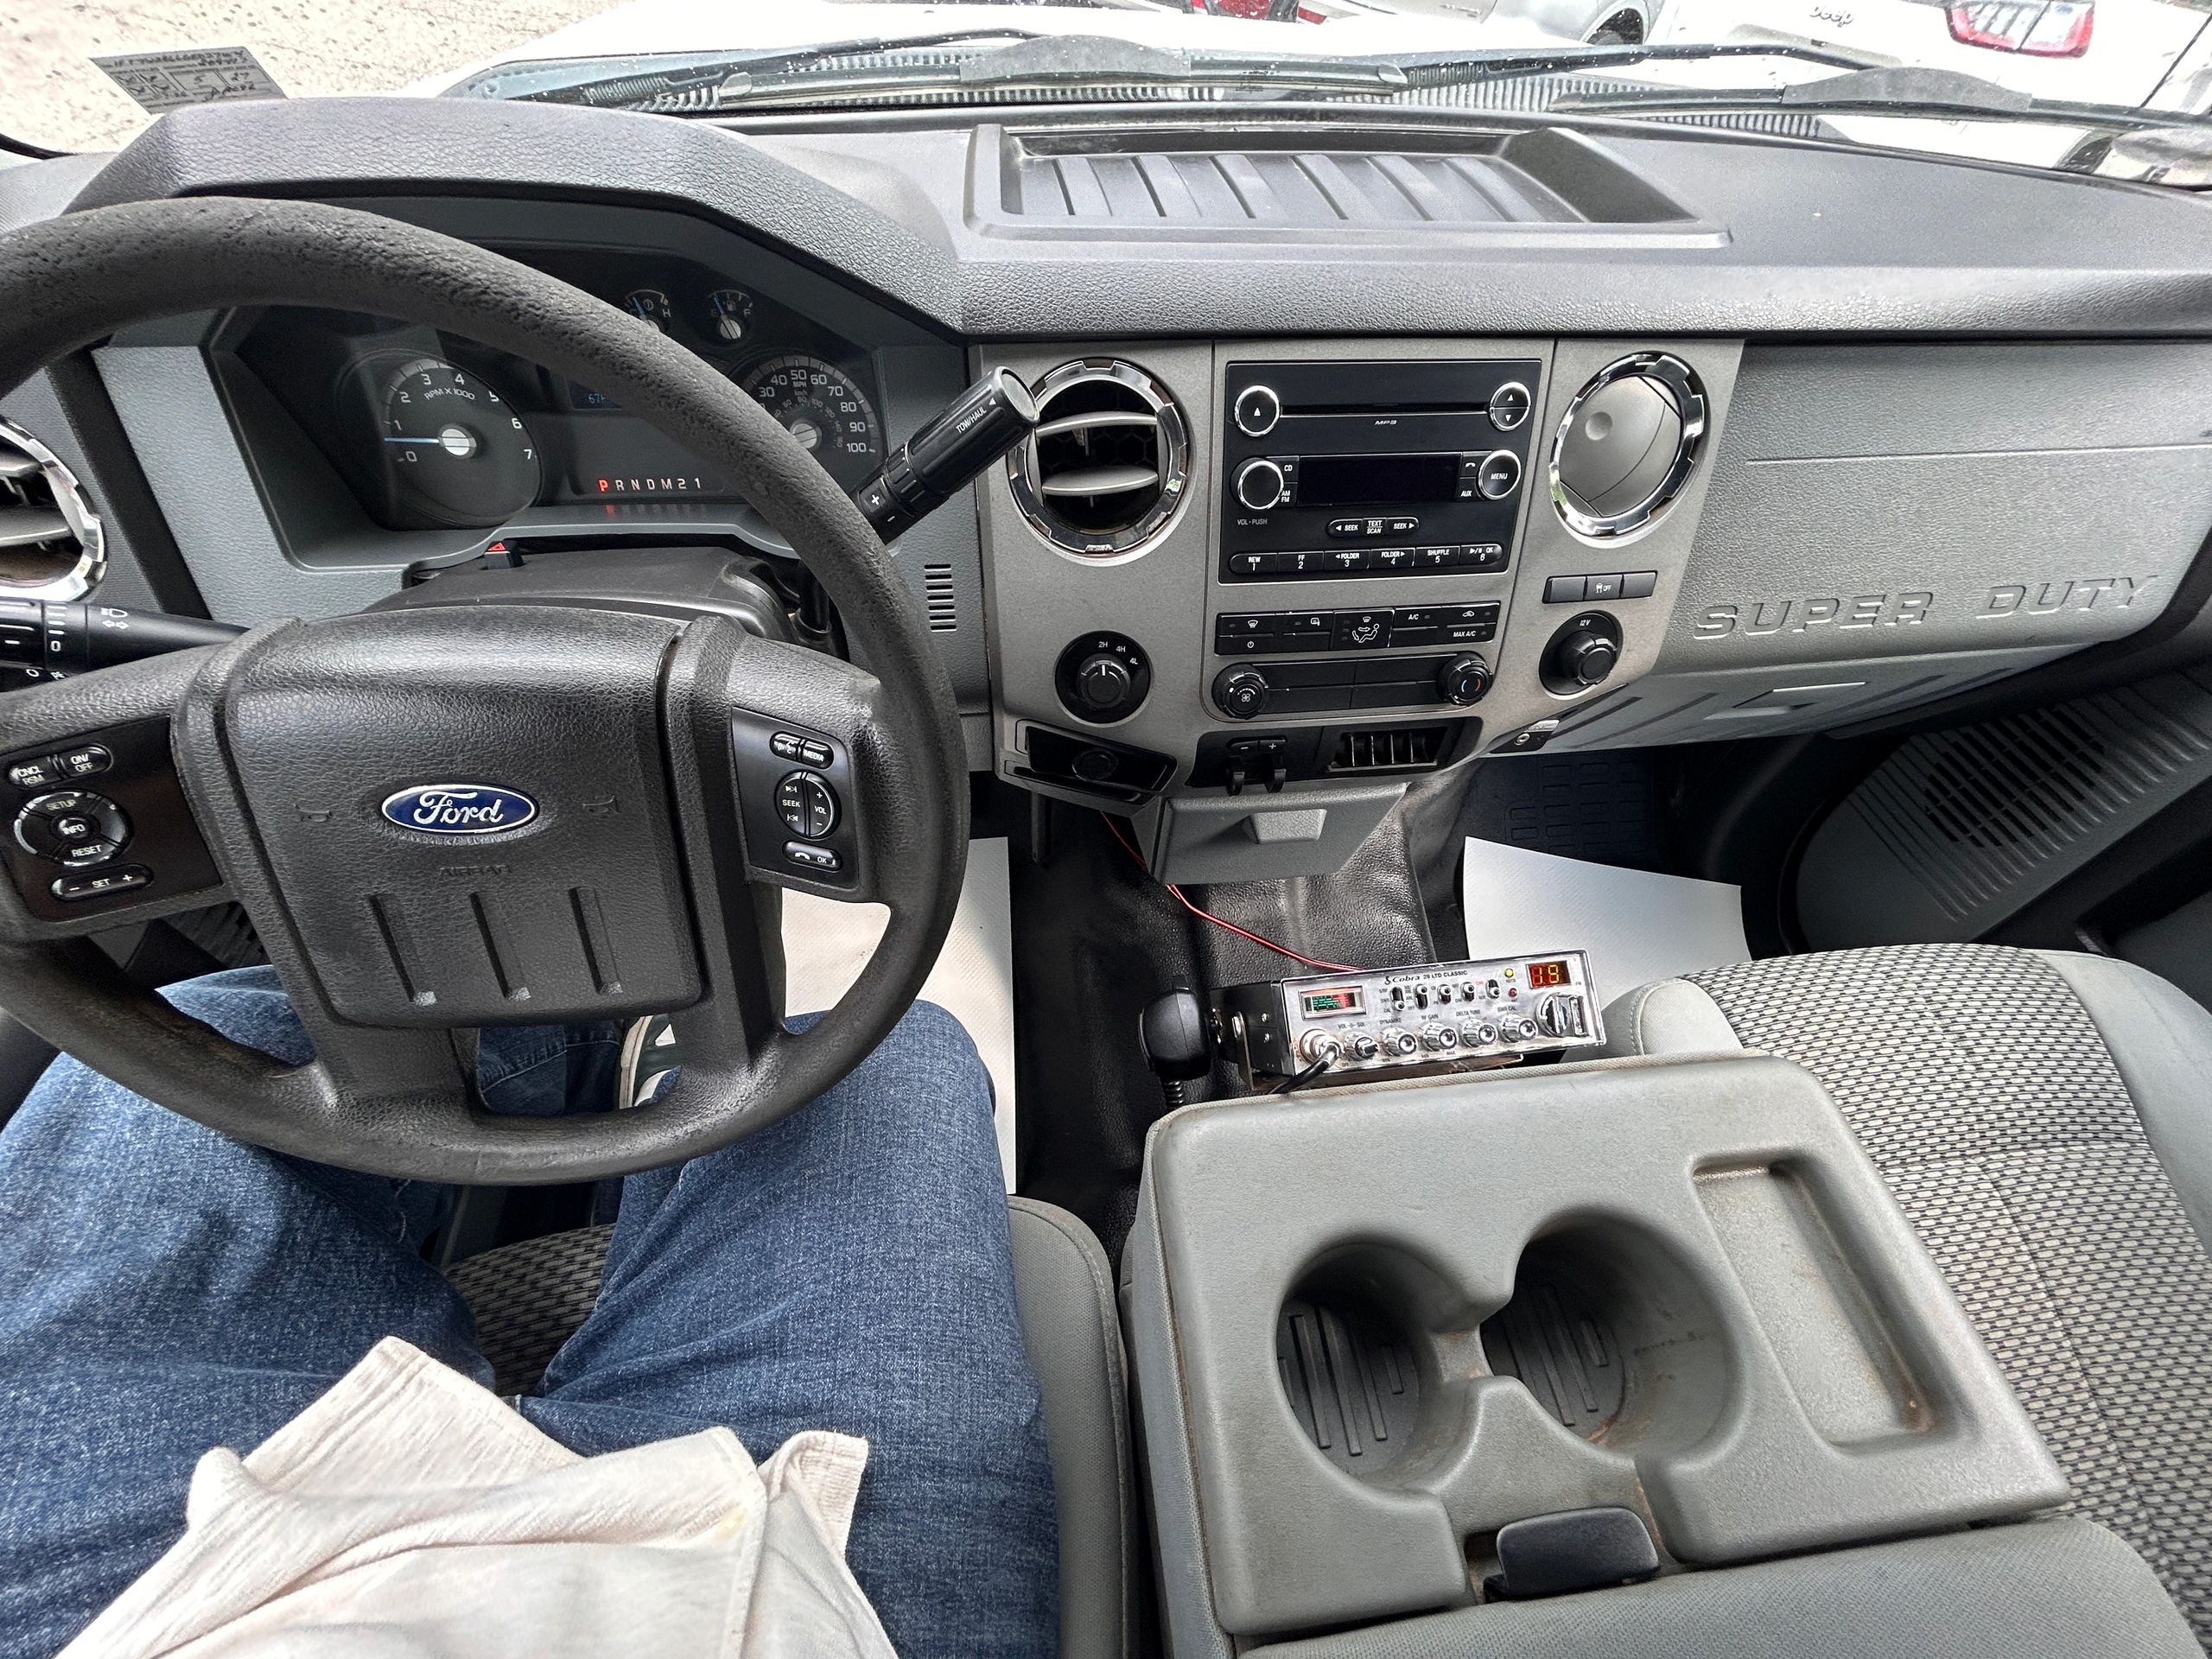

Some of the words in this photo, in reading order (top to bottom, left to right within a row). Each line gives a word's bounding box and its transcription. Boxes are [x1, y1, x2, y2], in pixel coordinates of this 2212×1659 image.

[421, 373, 431, 385] 3
[454, 373, 465, 385] 4
[771, 375, 787, 385] 40
[791, 370, 807, 380] 50
[810, 374, 827, 385] 60
[399, 391, 411, 403] 2
[423, 390, 442, 401] RPM
[453, 388, 475, 400] 1000
[760, 386, 775, 397] 30
[828, 386, 843, 397] 70
[840, 402, 857, 412] 80
[394, 419, 402, 430] 1
[512, 417, 522, 429] 6
[956, 406, 987, 434] TOW/HAUL
[849, 422, 865, 432] 90
[847, 442, 867, 453] 100
[406, 451, 417, 461] 0
[524, 449, 532, 460] 7
[1298, 561, 1304, 569] 2
[1694, 592, 1934, 639] SUPER
[1976, 575, 2160, 620] DUTY
[803, 749, 824, 762] MEDIA
[75, 762, 94, 772] OFF
[46, 798, 77, 810] SETUP
[413, 791, 505, 824] Ford
[782, 799, 801, 808] SEEK
[815, 805, 827, 815] VOL
[62, 823, 86, 836] INFO
[71, 844, 103, 857] RESET
[92, 878, 111, 889] SET
[1392, 975, 1421, 984] Cobra
[1444, 969, 1468, 978] CLASSIC
